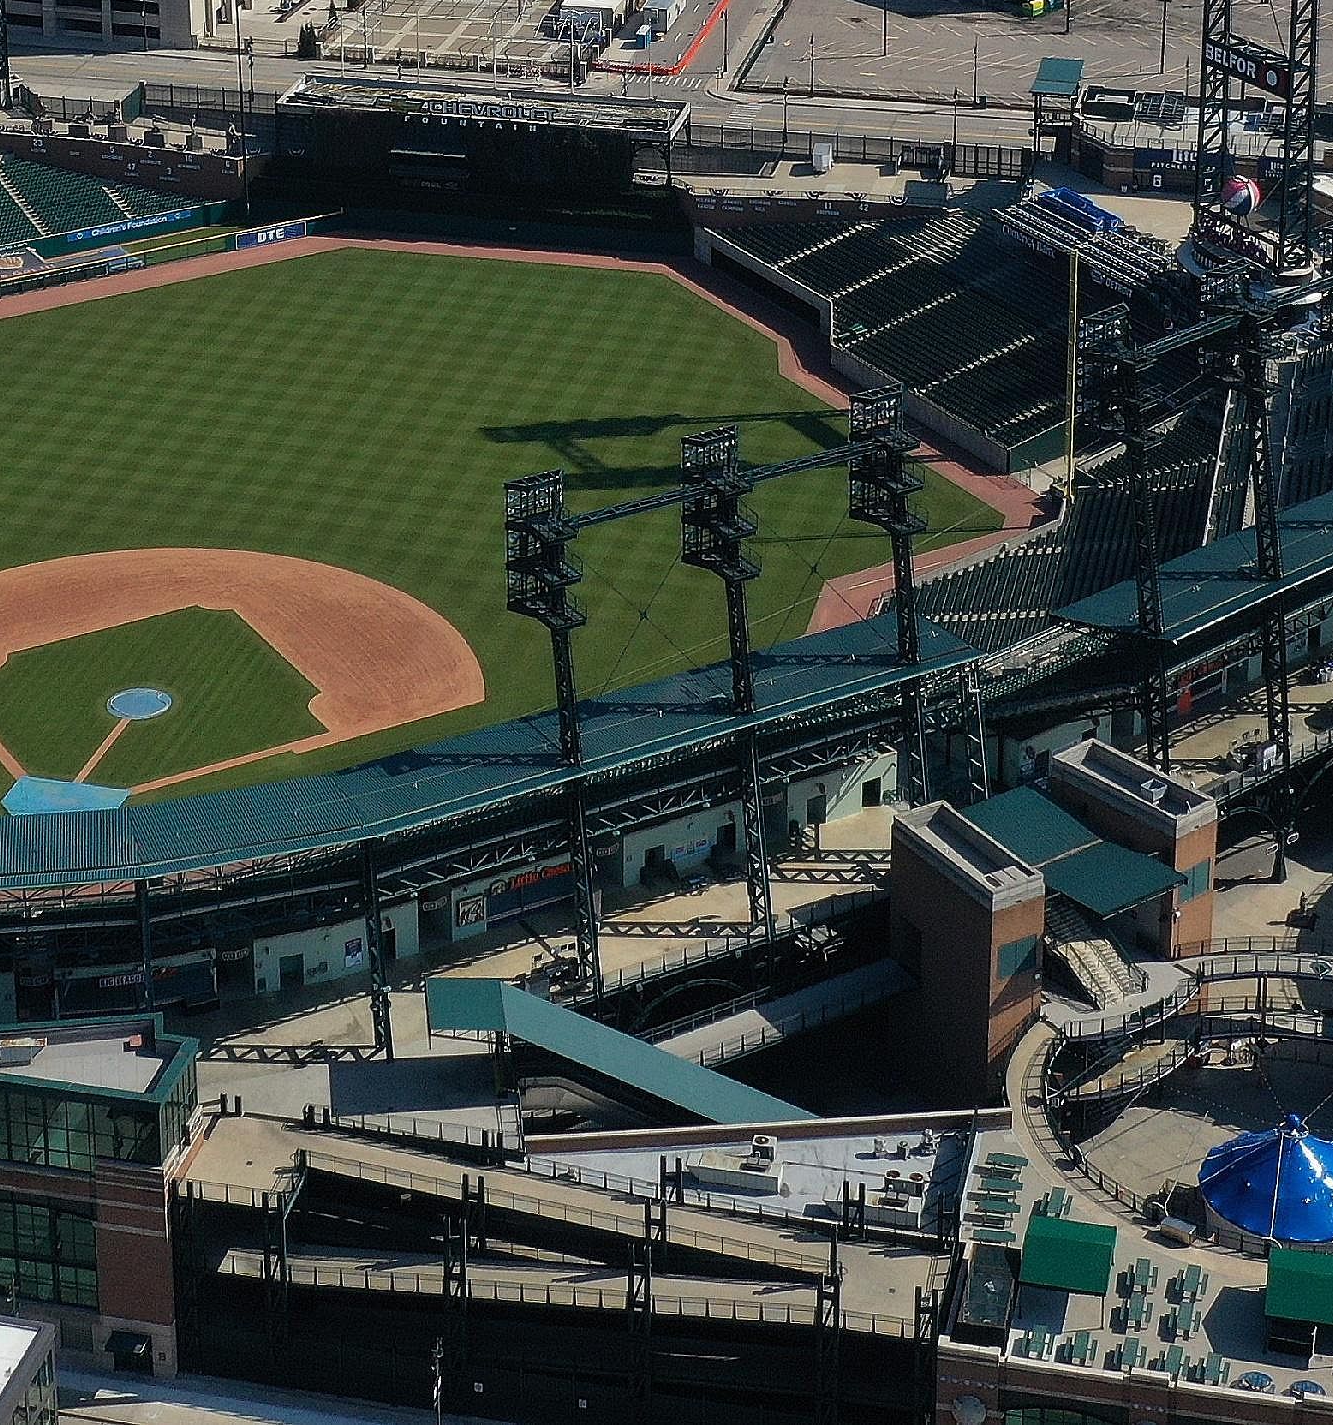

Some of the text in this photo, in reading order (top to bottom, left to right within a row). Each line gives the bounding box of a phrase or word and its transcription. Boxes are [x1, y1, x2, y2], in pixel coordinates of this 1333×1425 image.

[1205, 42, 1256, 79] BELFOR
[429, 101, 558, 121] CHEVROLET
[404, 115, 537, 132] FOUNTAIN
[257, 228, 285, 243] DTE
